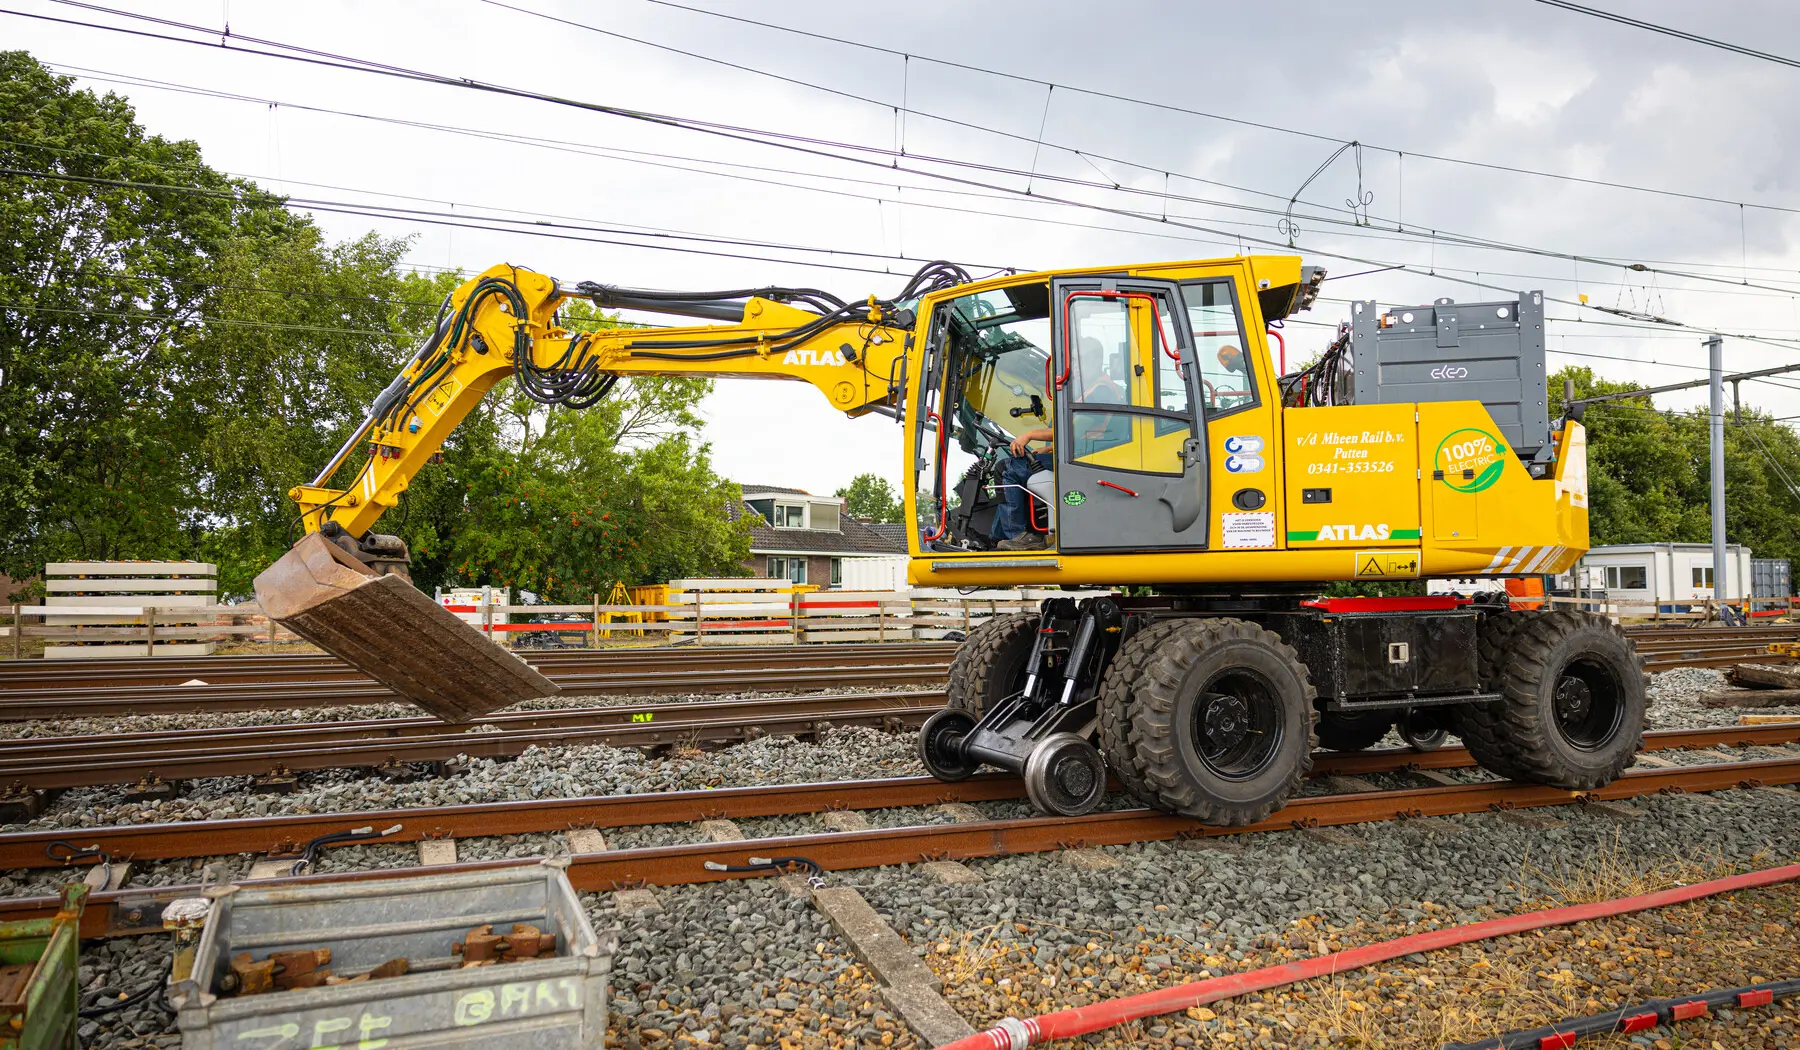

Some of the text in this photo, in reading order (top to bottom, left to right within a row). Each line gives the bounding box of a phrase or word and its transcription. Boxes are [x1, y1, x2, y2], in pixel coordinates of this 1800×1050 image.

[782, 349, 846, 367] ATLAS
[1296, 430, 1405, 447] v/d Mheen Rail b.v.
[1333, 447, 1368, 460] Putten
[1442, 436, 1493, 462] 100%
[1307, 461, 1395, 475] 0341-353526
[1447, 453, 1496, 474] ELECTRIC
[1317, 523, 1390, 541] ATLAS
